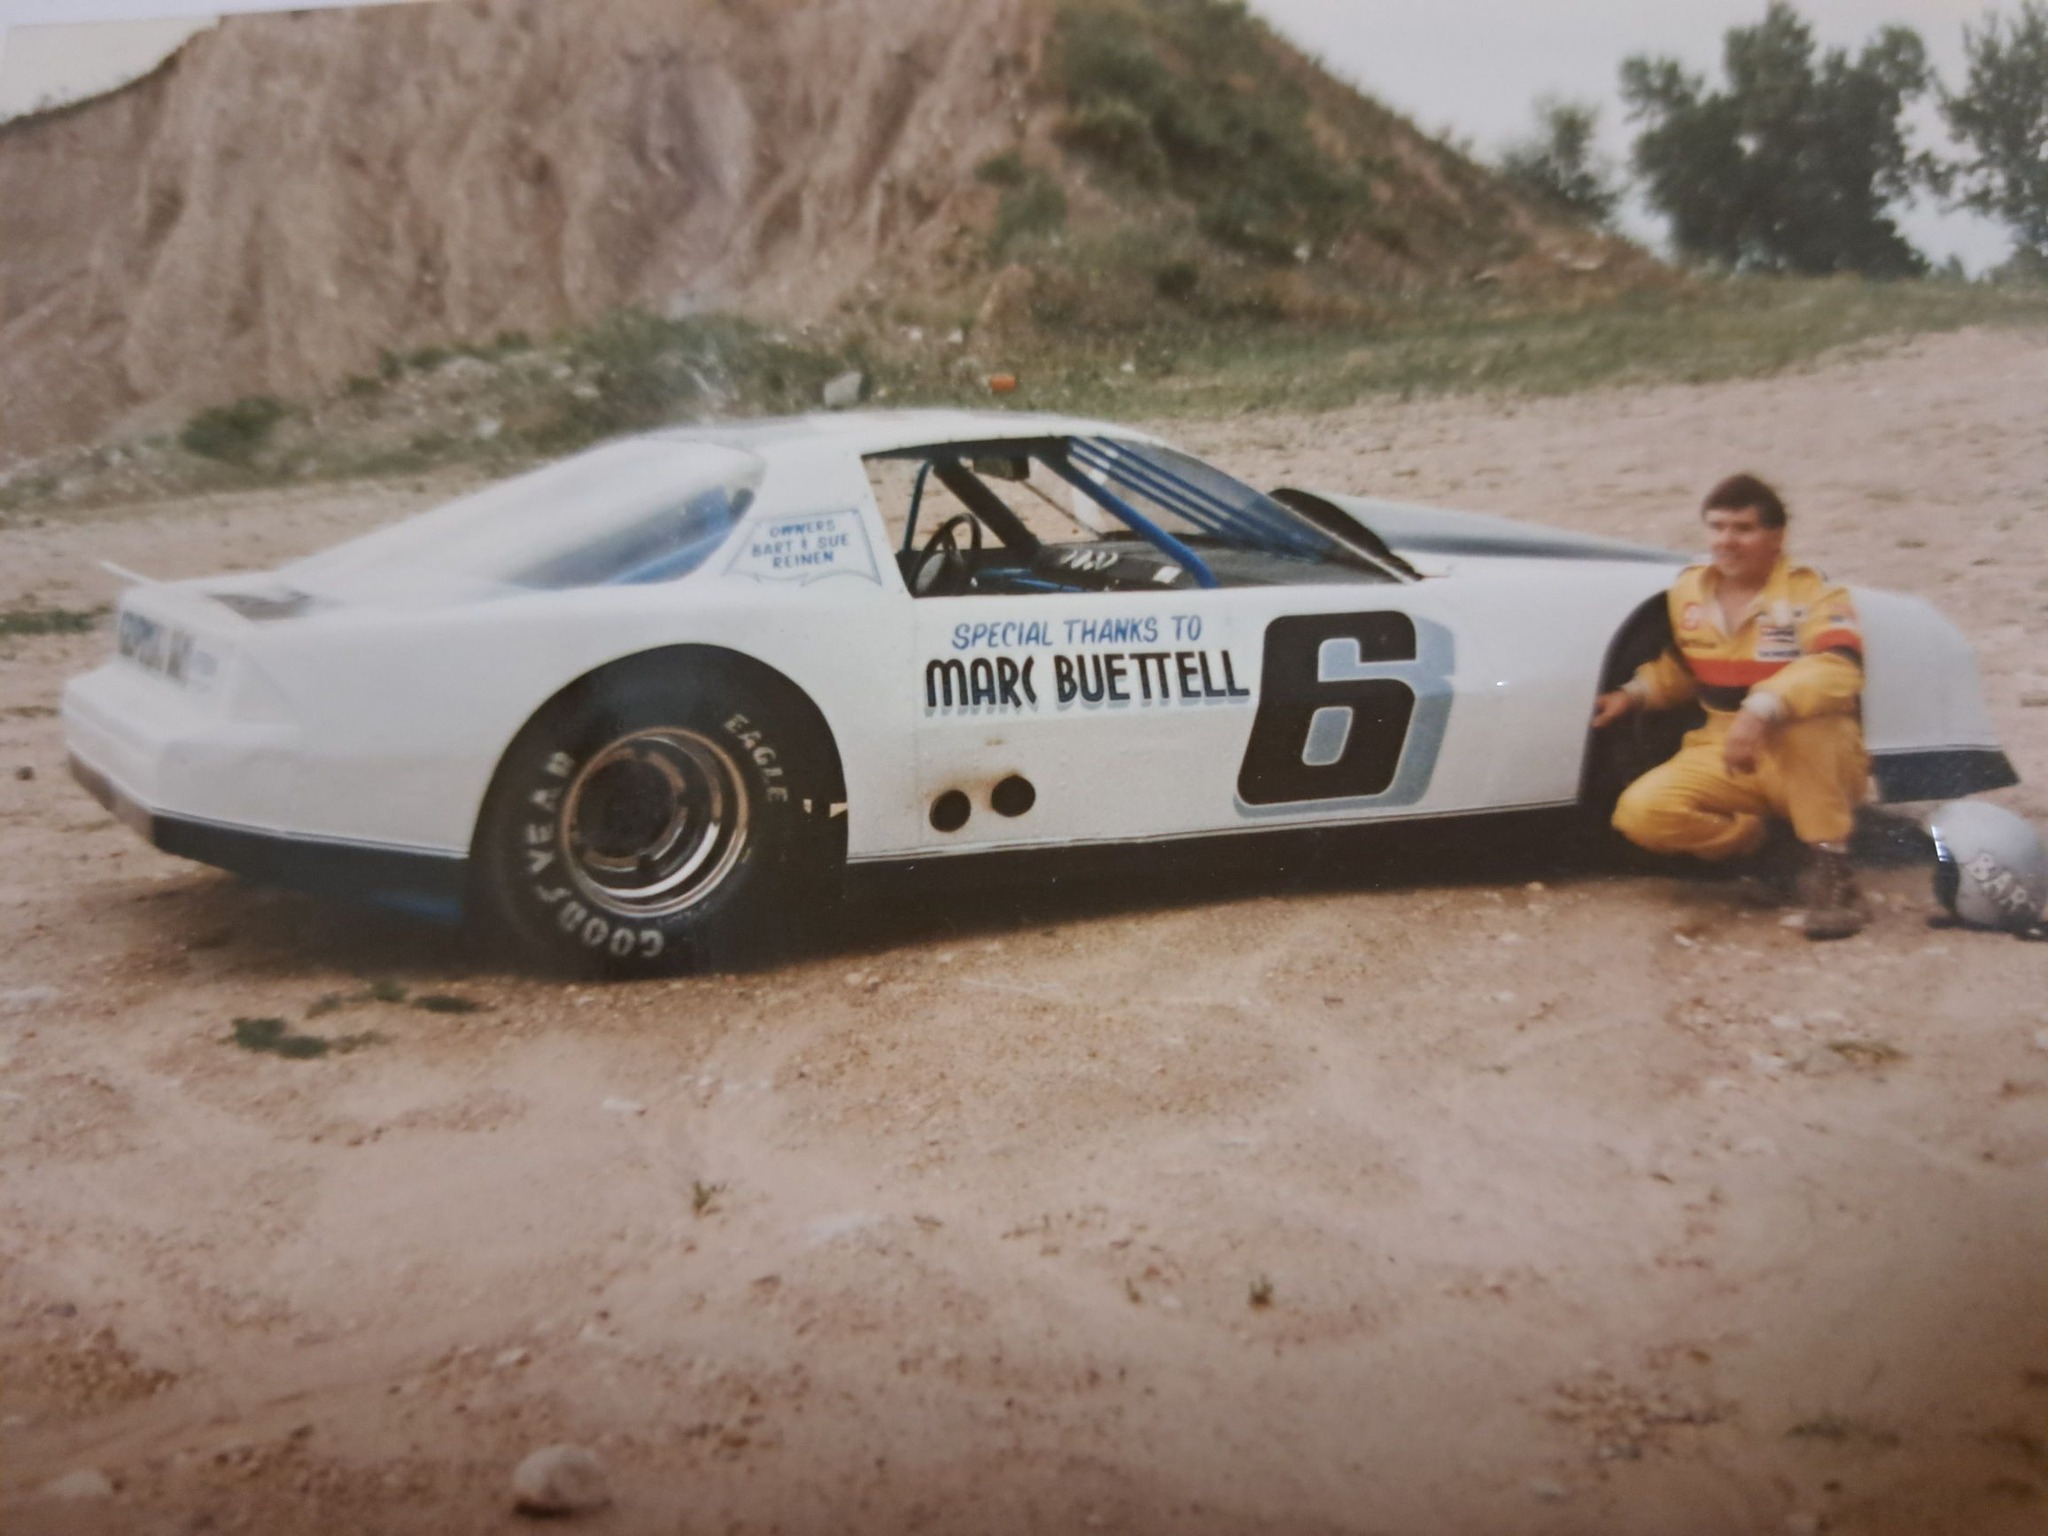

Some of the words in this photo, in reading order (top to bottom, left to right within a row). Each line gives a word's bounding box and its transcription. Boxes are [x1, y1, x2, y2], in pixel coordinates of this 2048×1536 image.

[751, 540, 793, 558] BART
[817, 534, 849, 550] SUE
[769, 519, 836, 538] OWNERS
[772, 551, 834, 569] REINEN
[951, 620, 1054, 650] SPECIAL
[1063, 616, 1159, 645] THANKS
[1171, 614, 1203, 642] TO
[924, 655, 1039, 712] MARC
[1053, 649, 1251, 704] BUETTELL
[1236, 610, 1420, 808] 6
[723, 713, 788, 803] EAGLE
[525, 751, 665, 957] GOODYEAR
